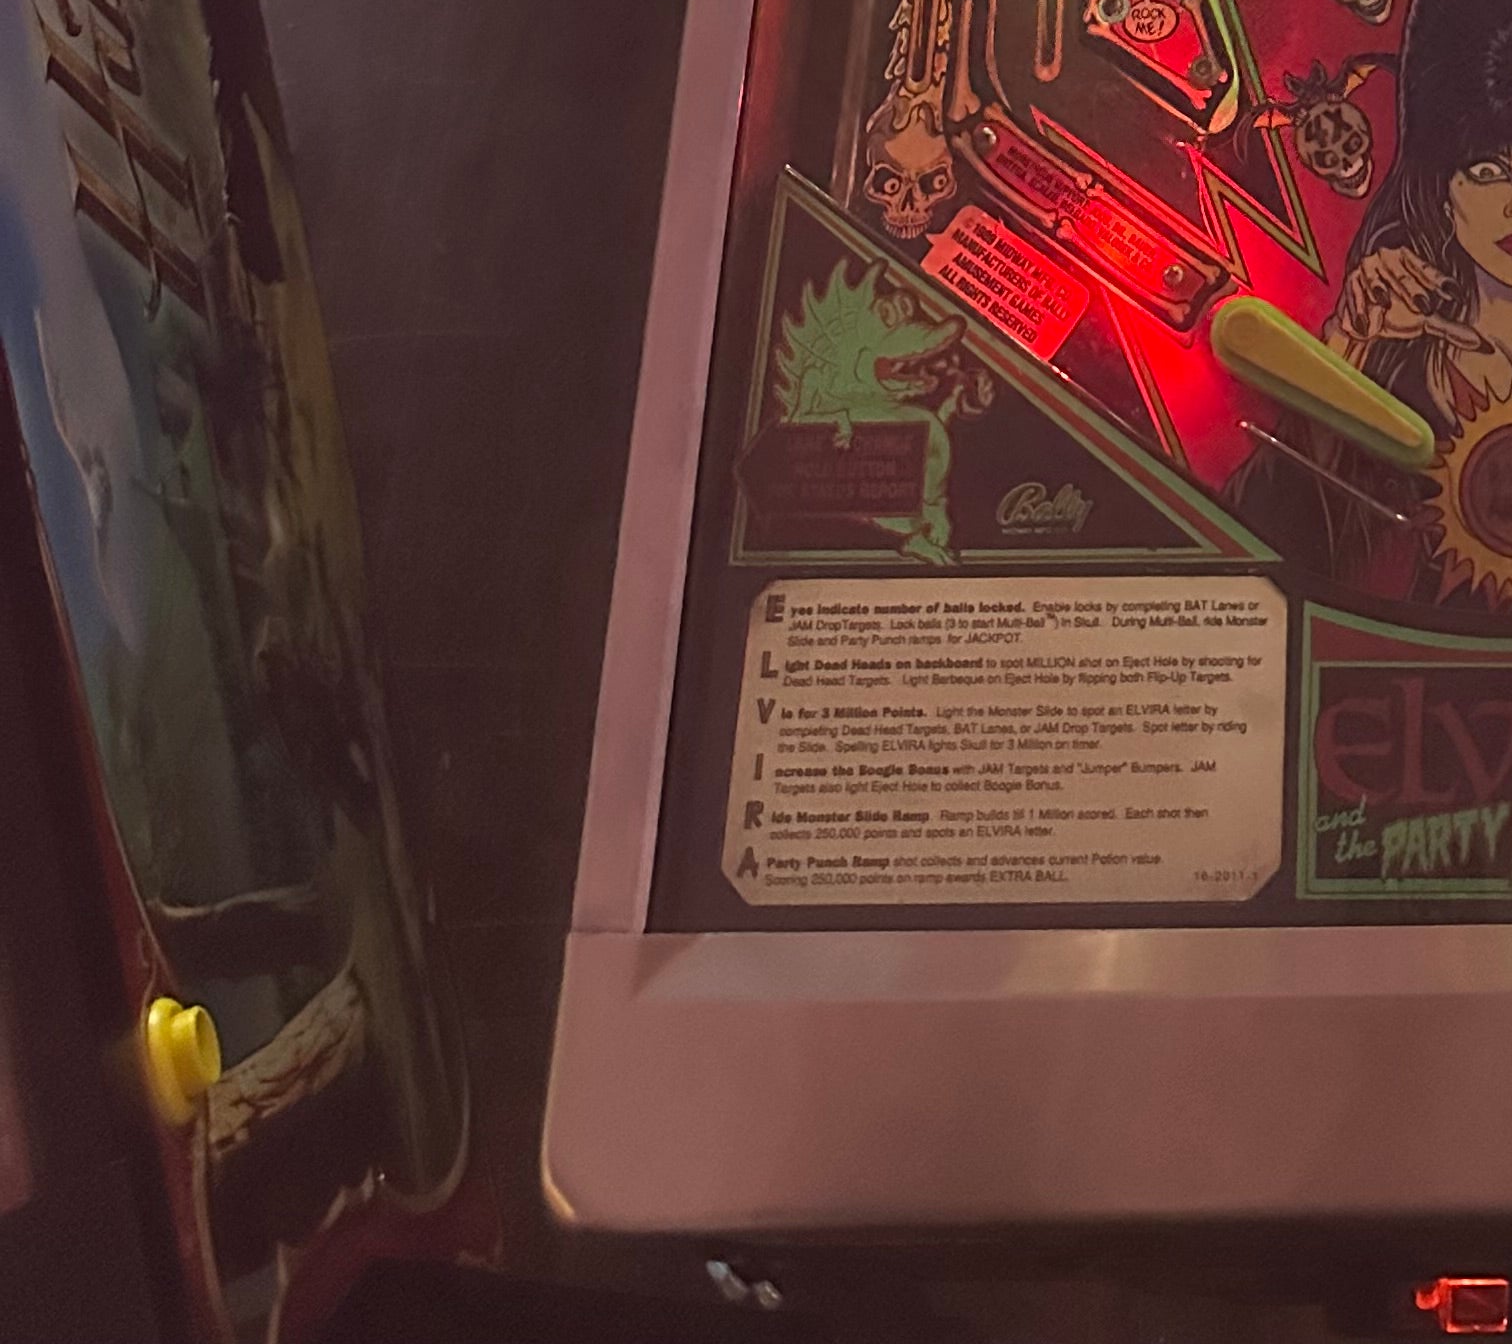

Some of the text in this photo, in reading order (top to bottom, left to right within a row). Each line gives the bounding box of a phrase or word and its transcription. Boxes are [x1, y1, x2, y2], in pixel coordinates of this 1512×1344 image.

[1131, 7, 1165, 21] ROCK
[1134, 19, 1165, 36] ME!
[939, 263, 1038, 344] ALL RIGHTS RESERVED
[995, 481, 1095, 533] Bally
[1184, 600, 1208, 613] BAT
[1315, 793, 1367, 833] and
[1334, 830, 1379, 865] the
[1379, 798, 1511, 882] PARTY
